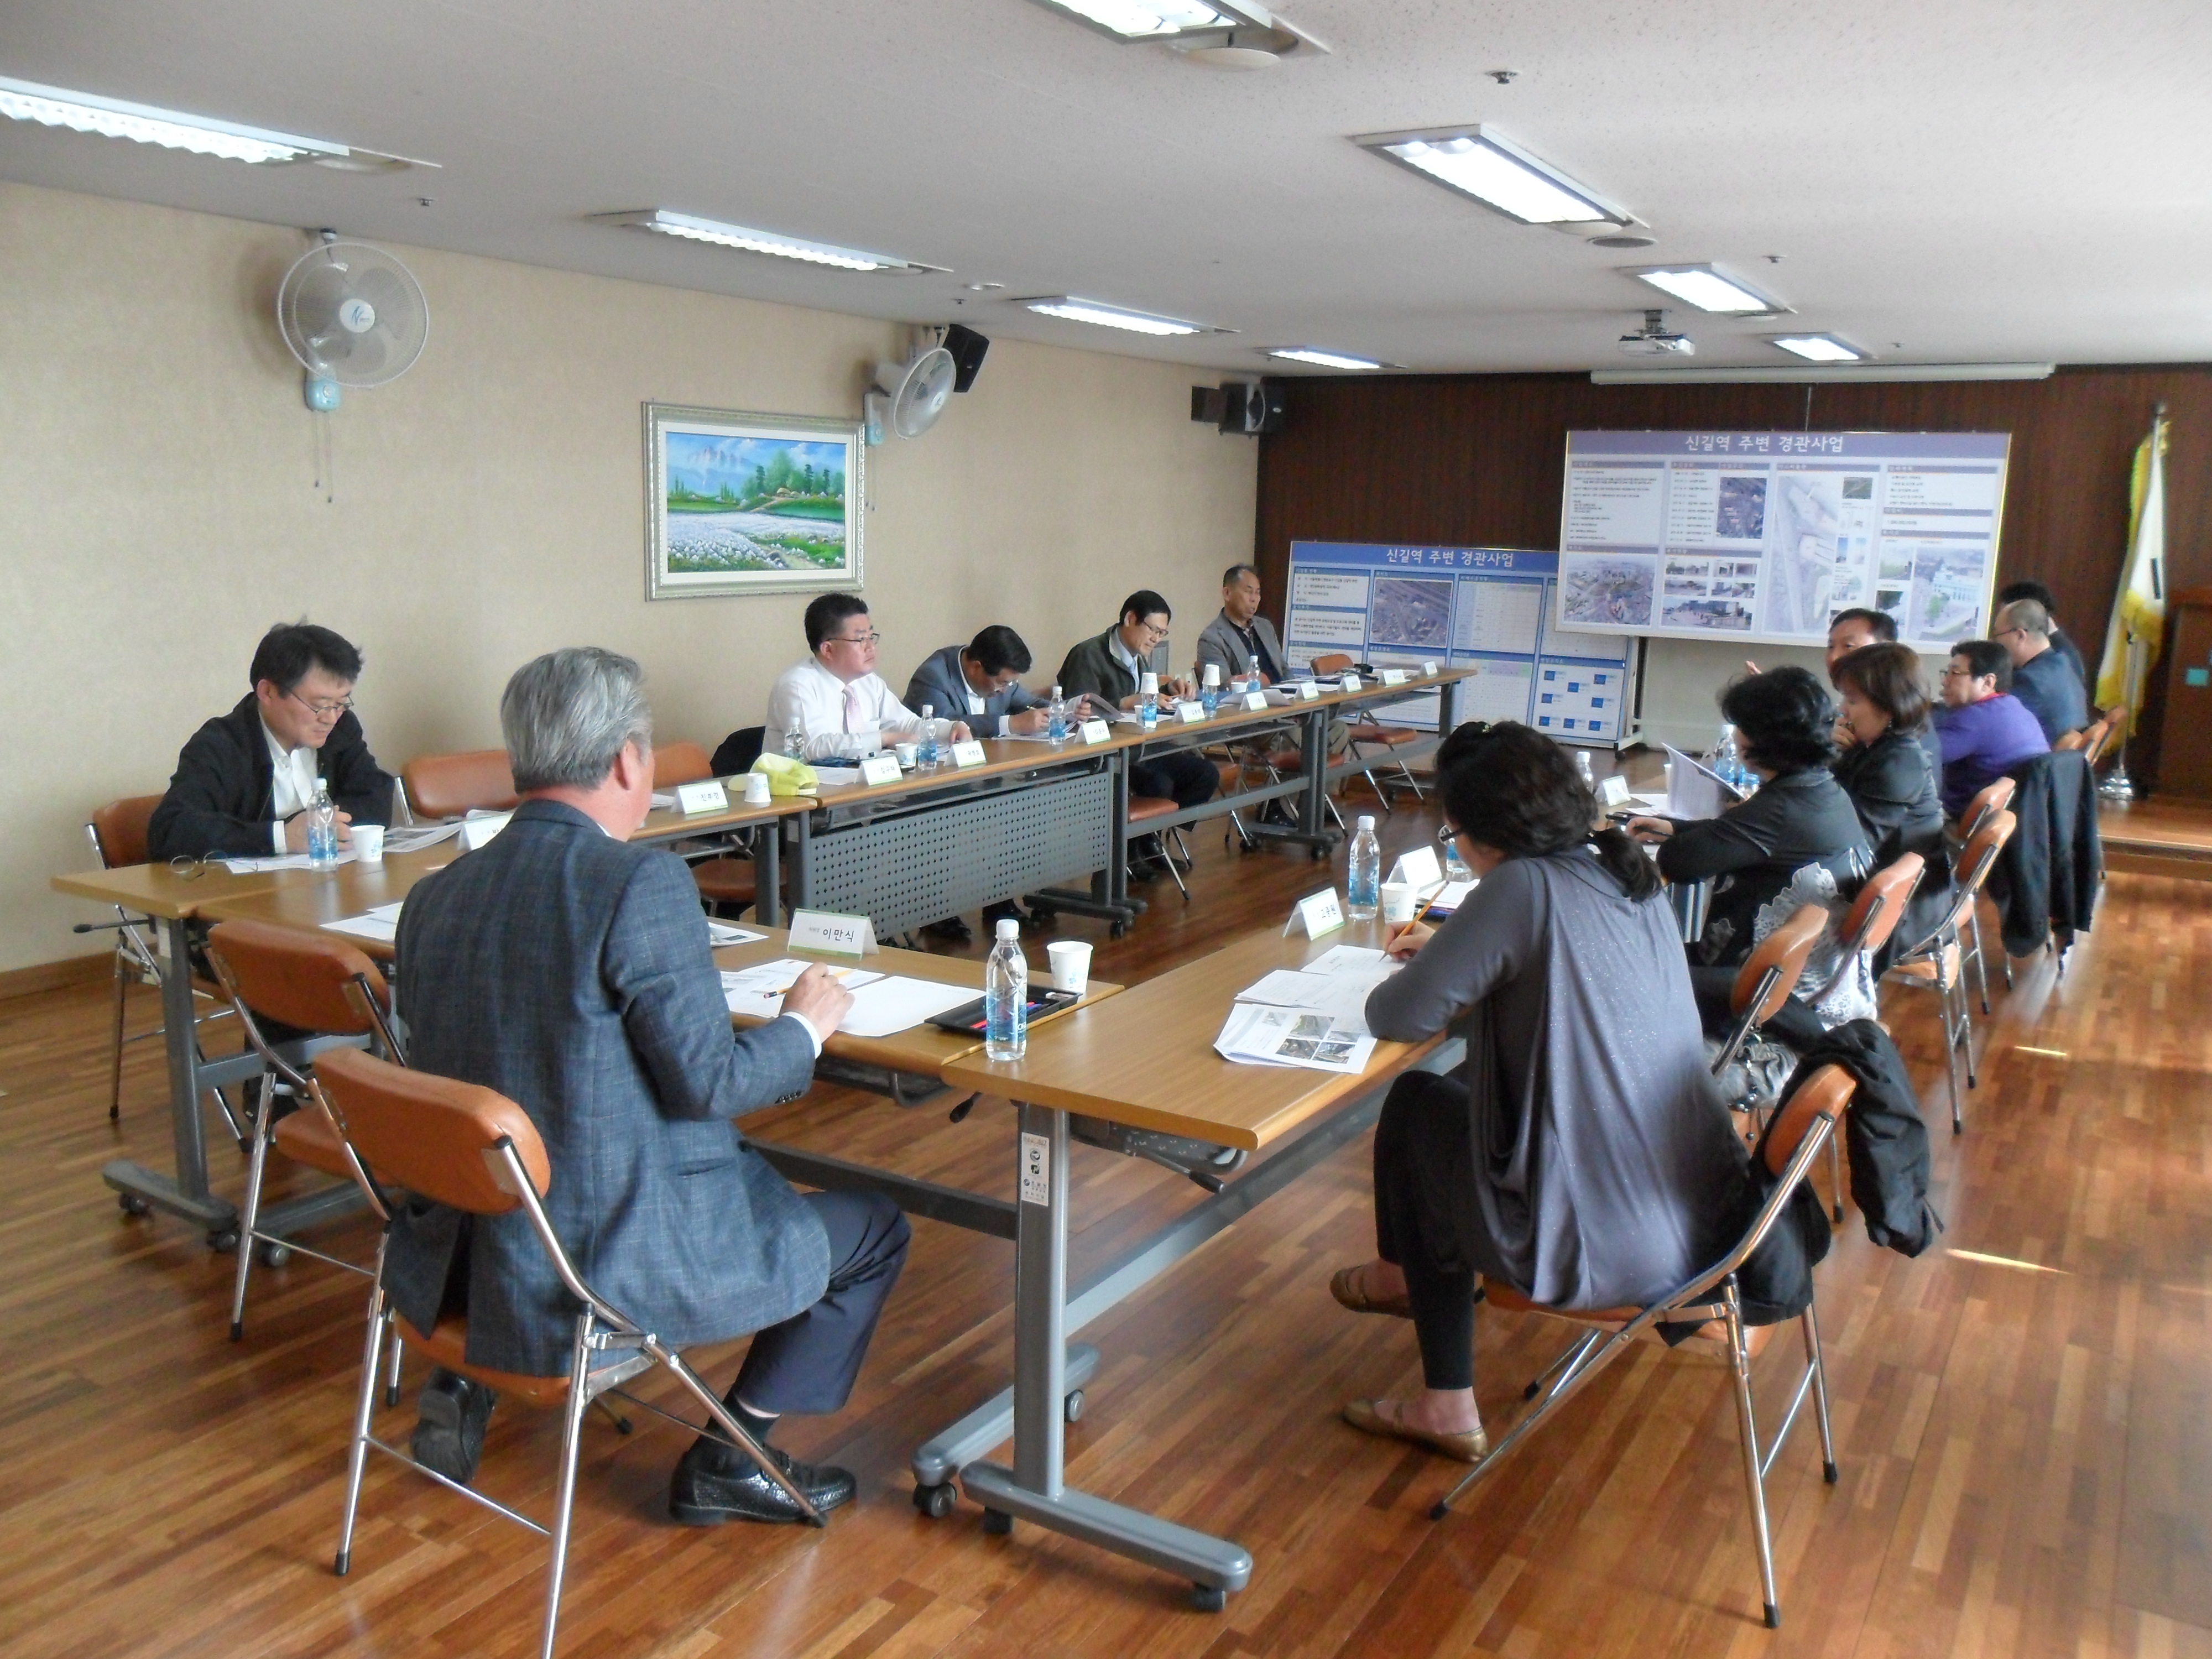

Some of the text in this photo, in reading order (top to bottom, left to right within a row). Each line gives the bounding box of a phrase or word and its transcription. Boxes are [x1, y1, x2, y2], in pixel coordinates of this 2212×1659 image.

[1685, 435, 1844, 453] 신길역 주변 경관사업
[1386, 548, 1514, 567] 신길역 주변 경관사업
[822, 927, 854, 943] 이만식
